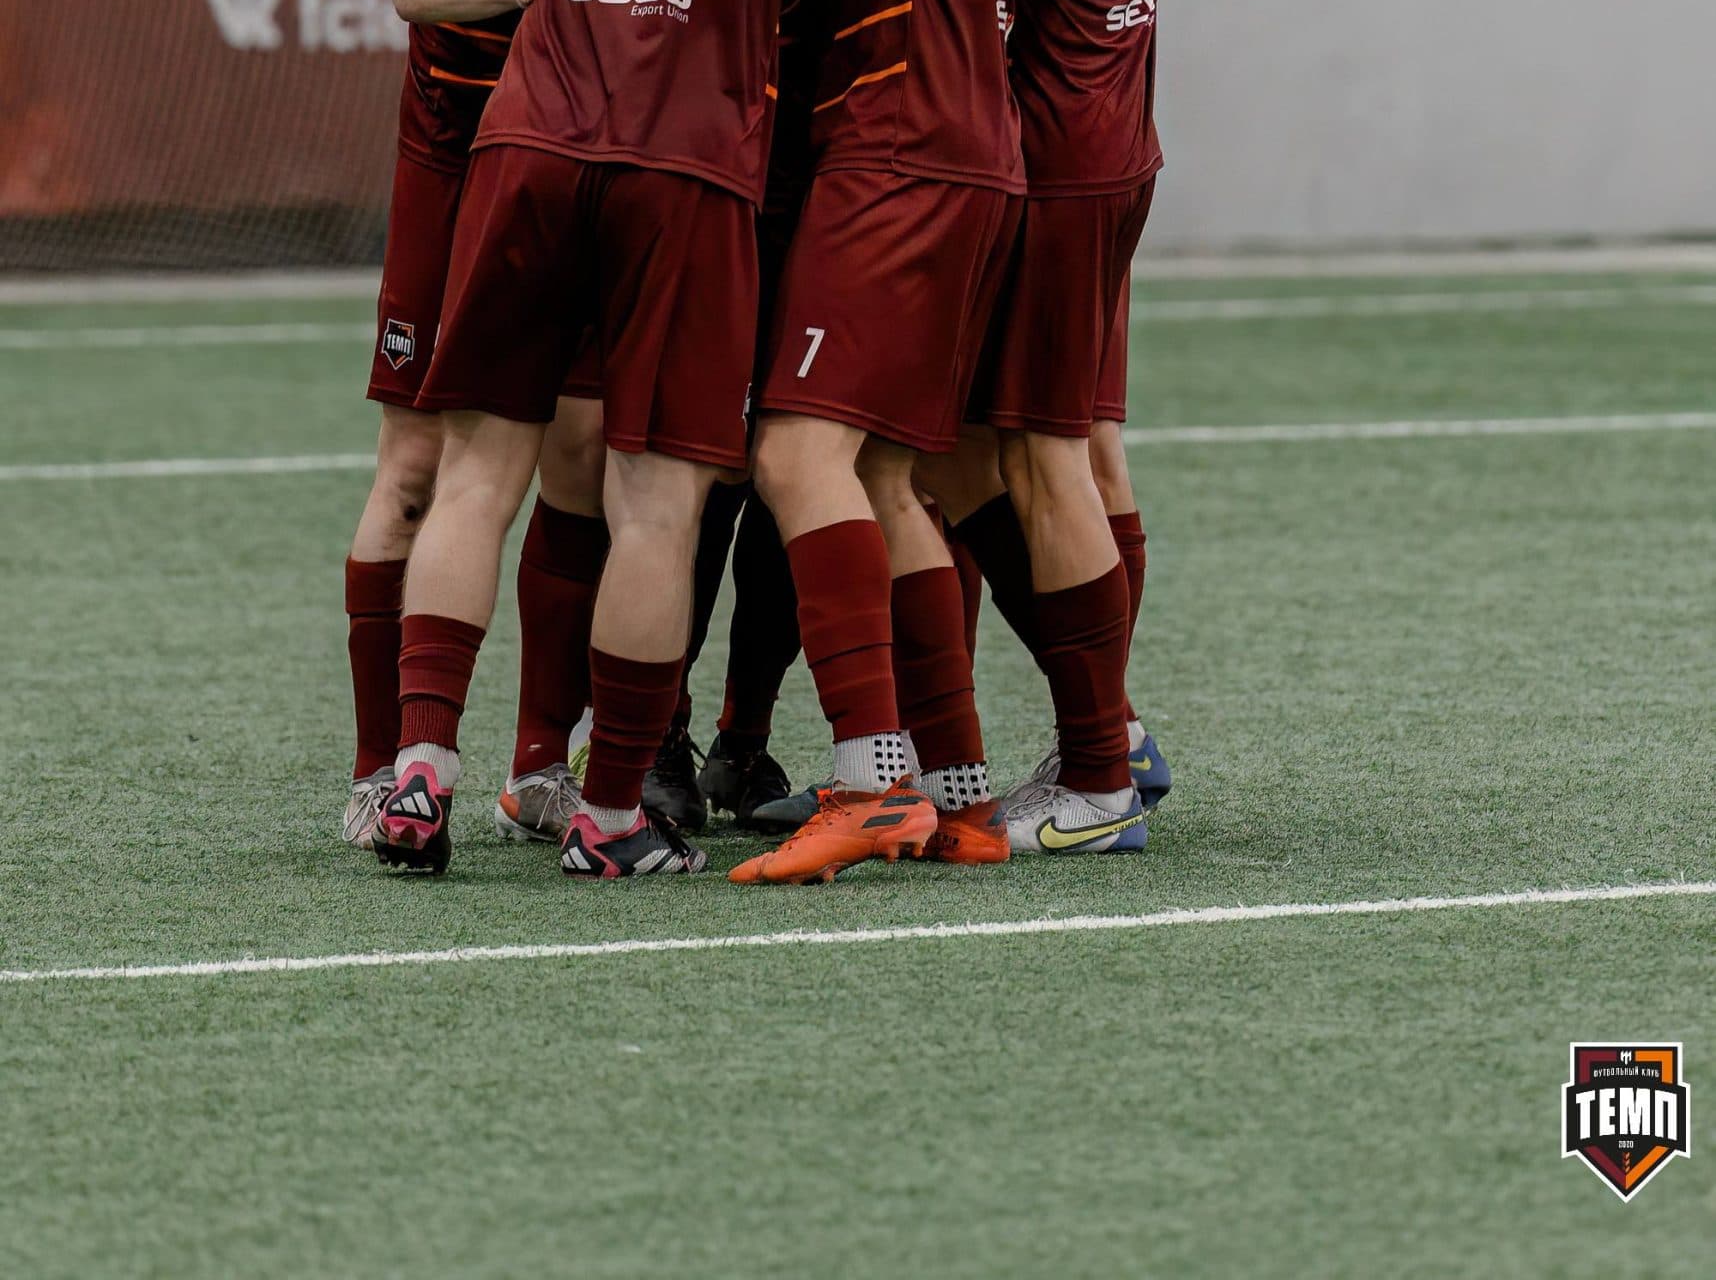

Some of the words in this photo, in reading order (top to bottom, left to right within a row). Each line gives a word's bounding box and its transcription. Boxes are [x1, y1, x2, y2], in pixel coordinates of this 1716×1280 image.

[630, 4, 664, 17] Export
[386, 333, 411, 355] ТЕМП
[797, 327, 825, 378] 7
